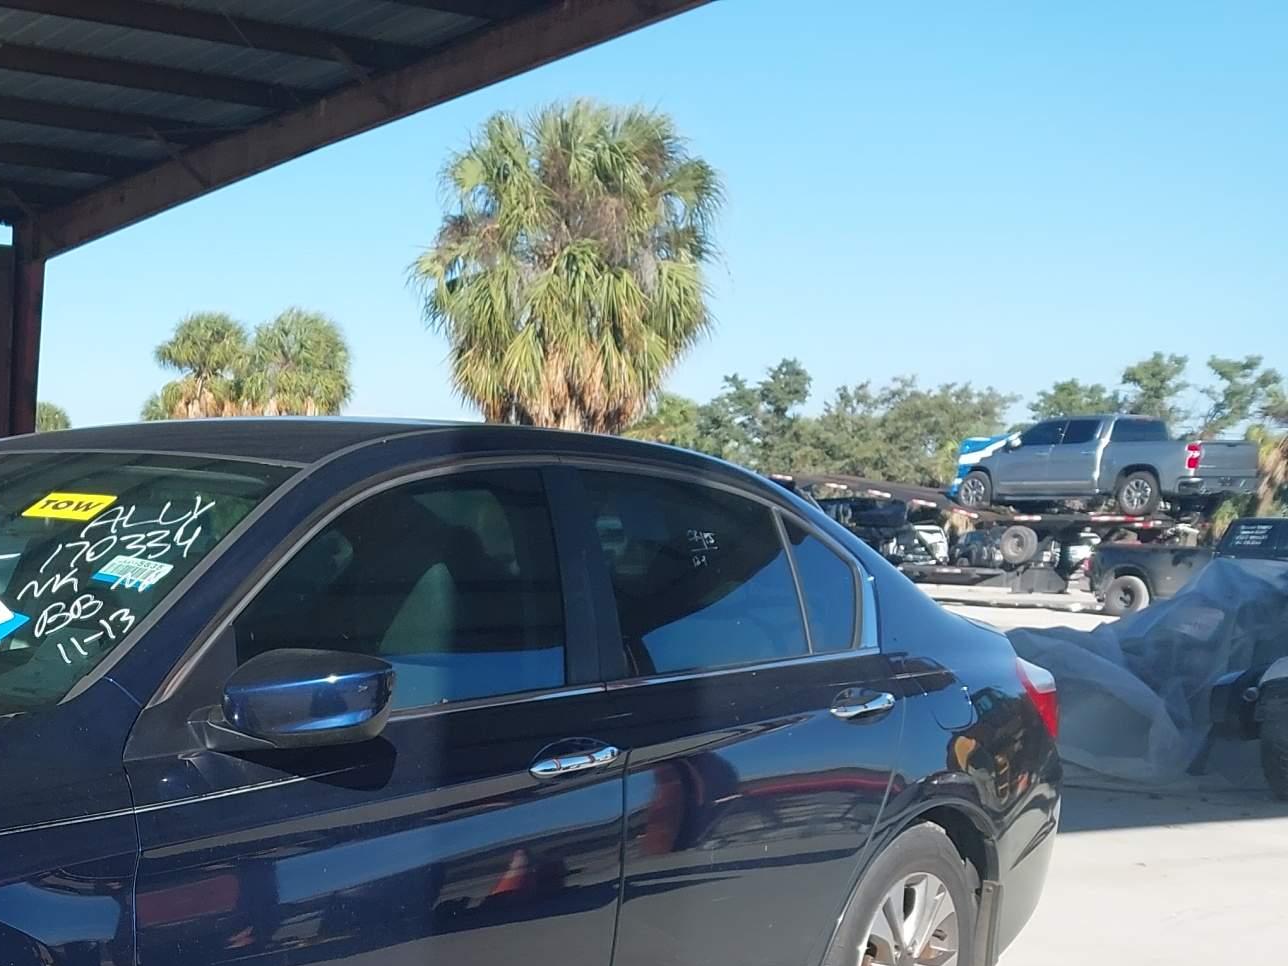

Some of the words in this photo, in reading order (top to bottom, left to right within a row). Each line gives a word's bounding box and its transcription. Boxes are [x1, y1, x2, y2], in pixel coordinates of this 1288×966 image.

[39, 499, 103, 514] TOW
[80, 494, 216, 538] ALLY
[40, 525, 202, 574] 170334
[57, 608, 136, 664] 11-13
